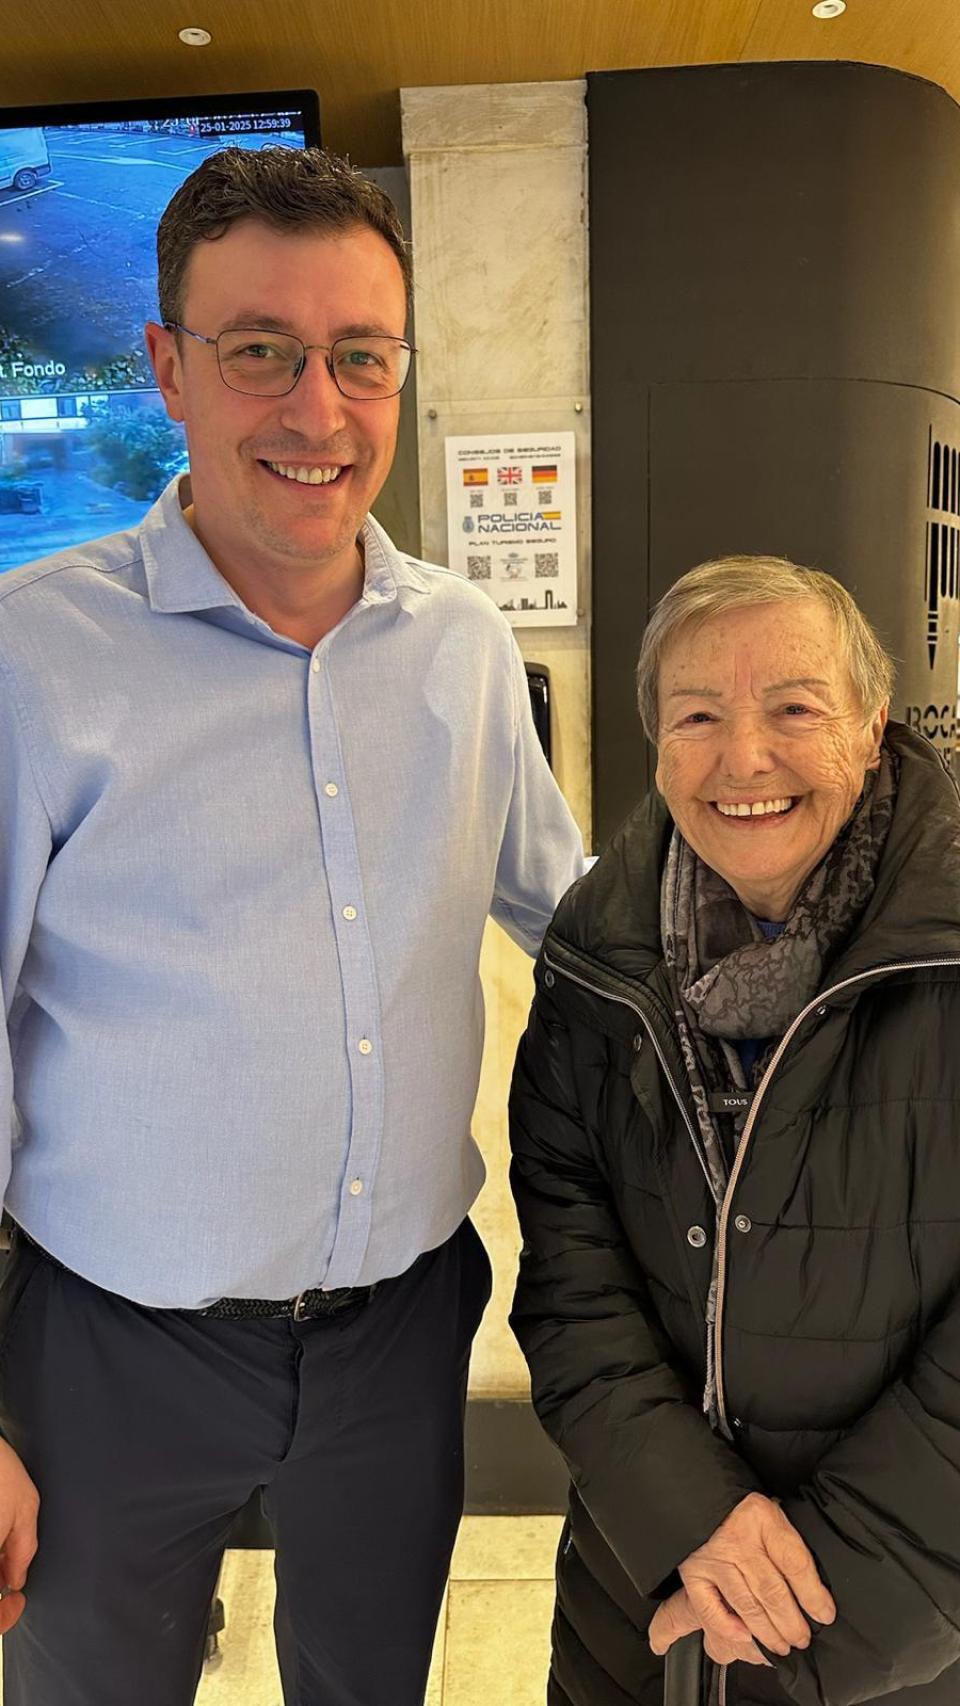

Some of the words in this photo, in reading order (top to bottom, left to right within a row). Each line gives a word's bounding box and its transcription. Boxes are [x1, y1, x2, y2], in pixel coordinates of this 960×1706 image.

[200, 120, 252, 132] 25-01-2025
[253, 117, 291, 130] 12:59:39
[11, 360, 66, 377] Fondo
[478, 512, 544, 523] POLICIA
[478, 522, 562, 533] NACIONAL
[723, 1098, 748, 1106] TOUS
